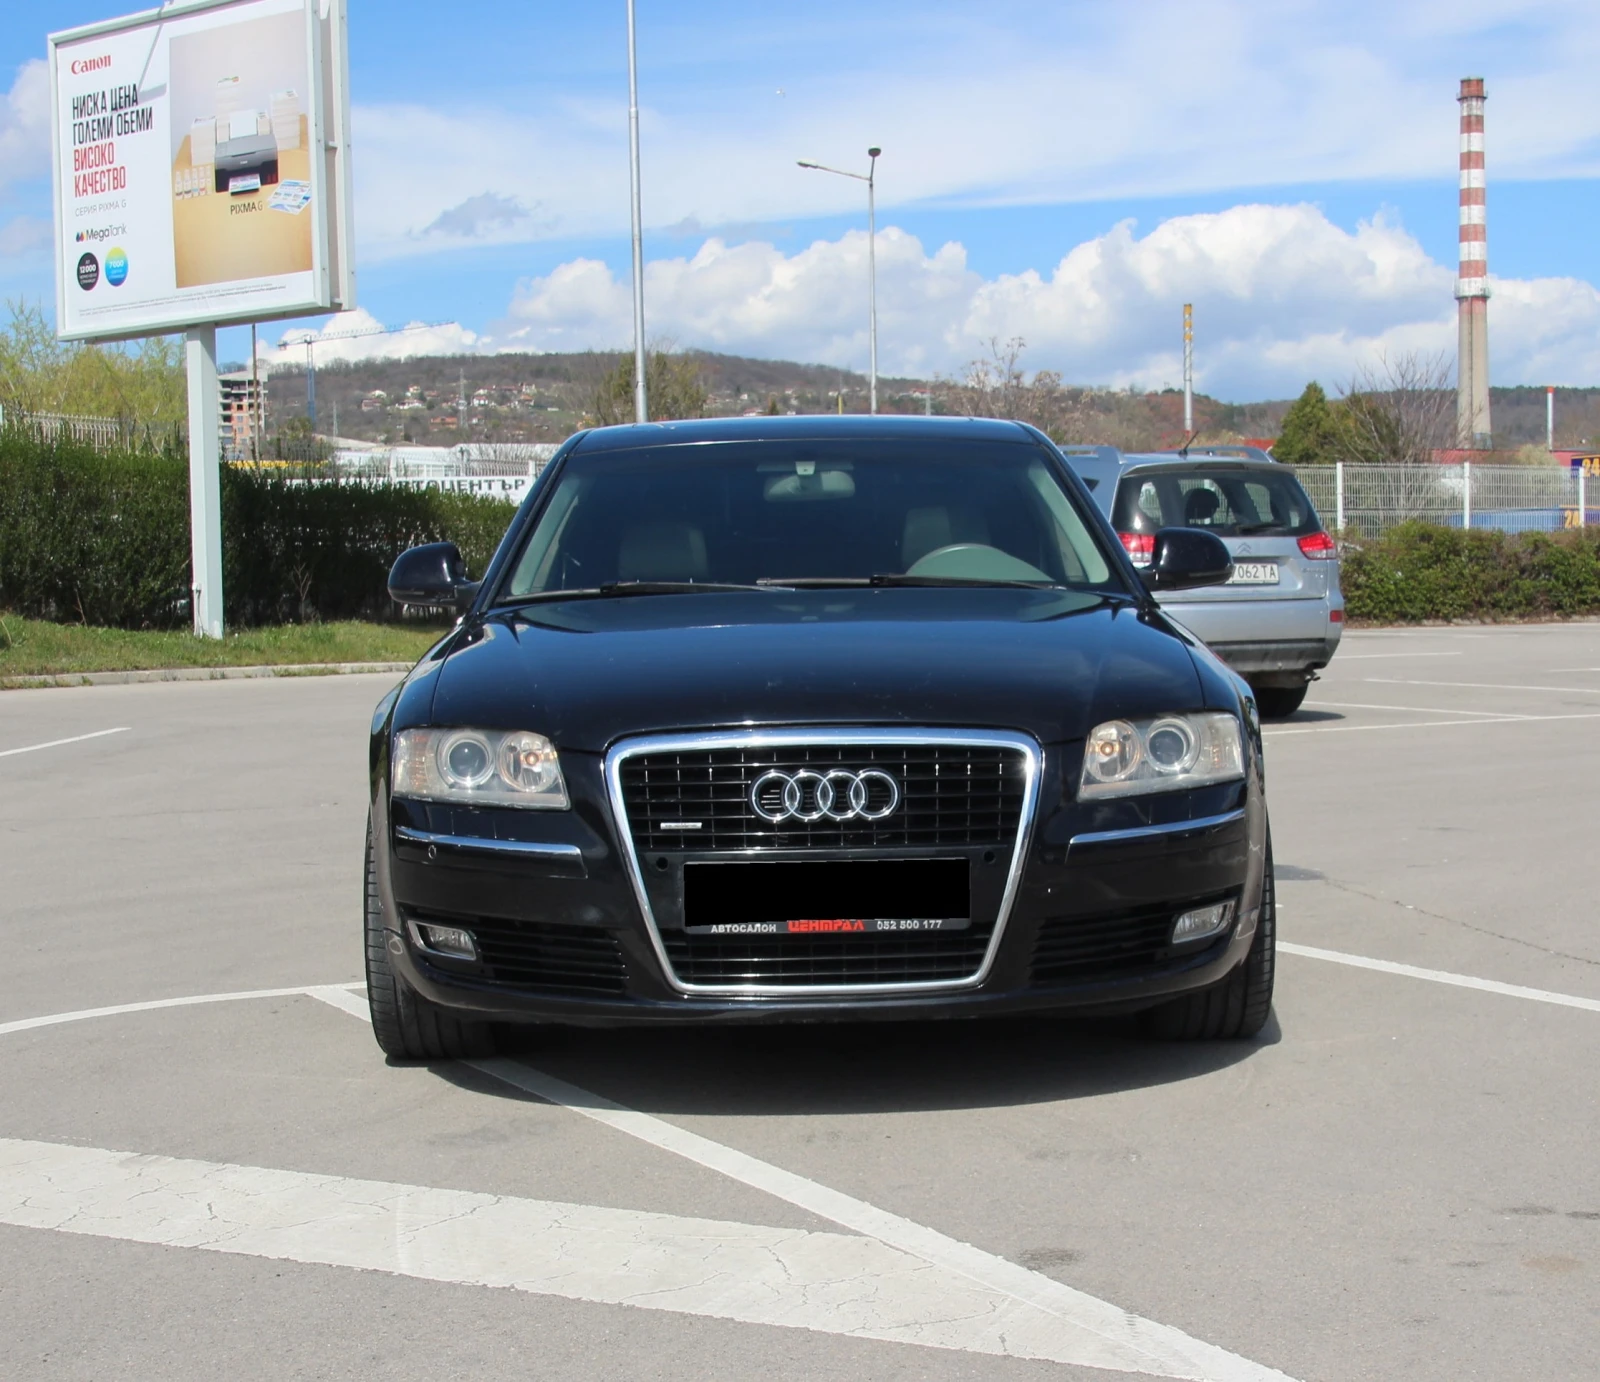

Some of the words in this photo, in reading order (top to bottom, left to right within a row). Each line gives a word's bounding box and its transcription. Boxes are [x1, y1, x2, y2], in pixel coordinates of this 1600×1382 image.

[71, 55, 111, 75] Canon
[72, 91, 107, 120] НИСКА
[110, 83, 138, 112] ЦЕНА
[73, 115, 113, 146] ГОЛЕМИ
[116, 106, 153, 137] ОБЕМИ
[74, 142, 114, 172] ВИСОКО
[74, 166, 126, 198] КАЧЕСТВО
[75, 204, 97, 217] СЕРИЯ
[98, 200, 120, 212] PIXMA
[121, 199, 127, 208] G
[230, 202, 257, 215] PIXMA
[257, 200, 263, 211] G
[86, 224, 127, 242] MegaTank
[711, 924, 777, 933] АВТОСАЛОН
[877, 920, 897, 930] 052
[900, 920, 920, 930] 500
[923, 920, 942, 930] 177
